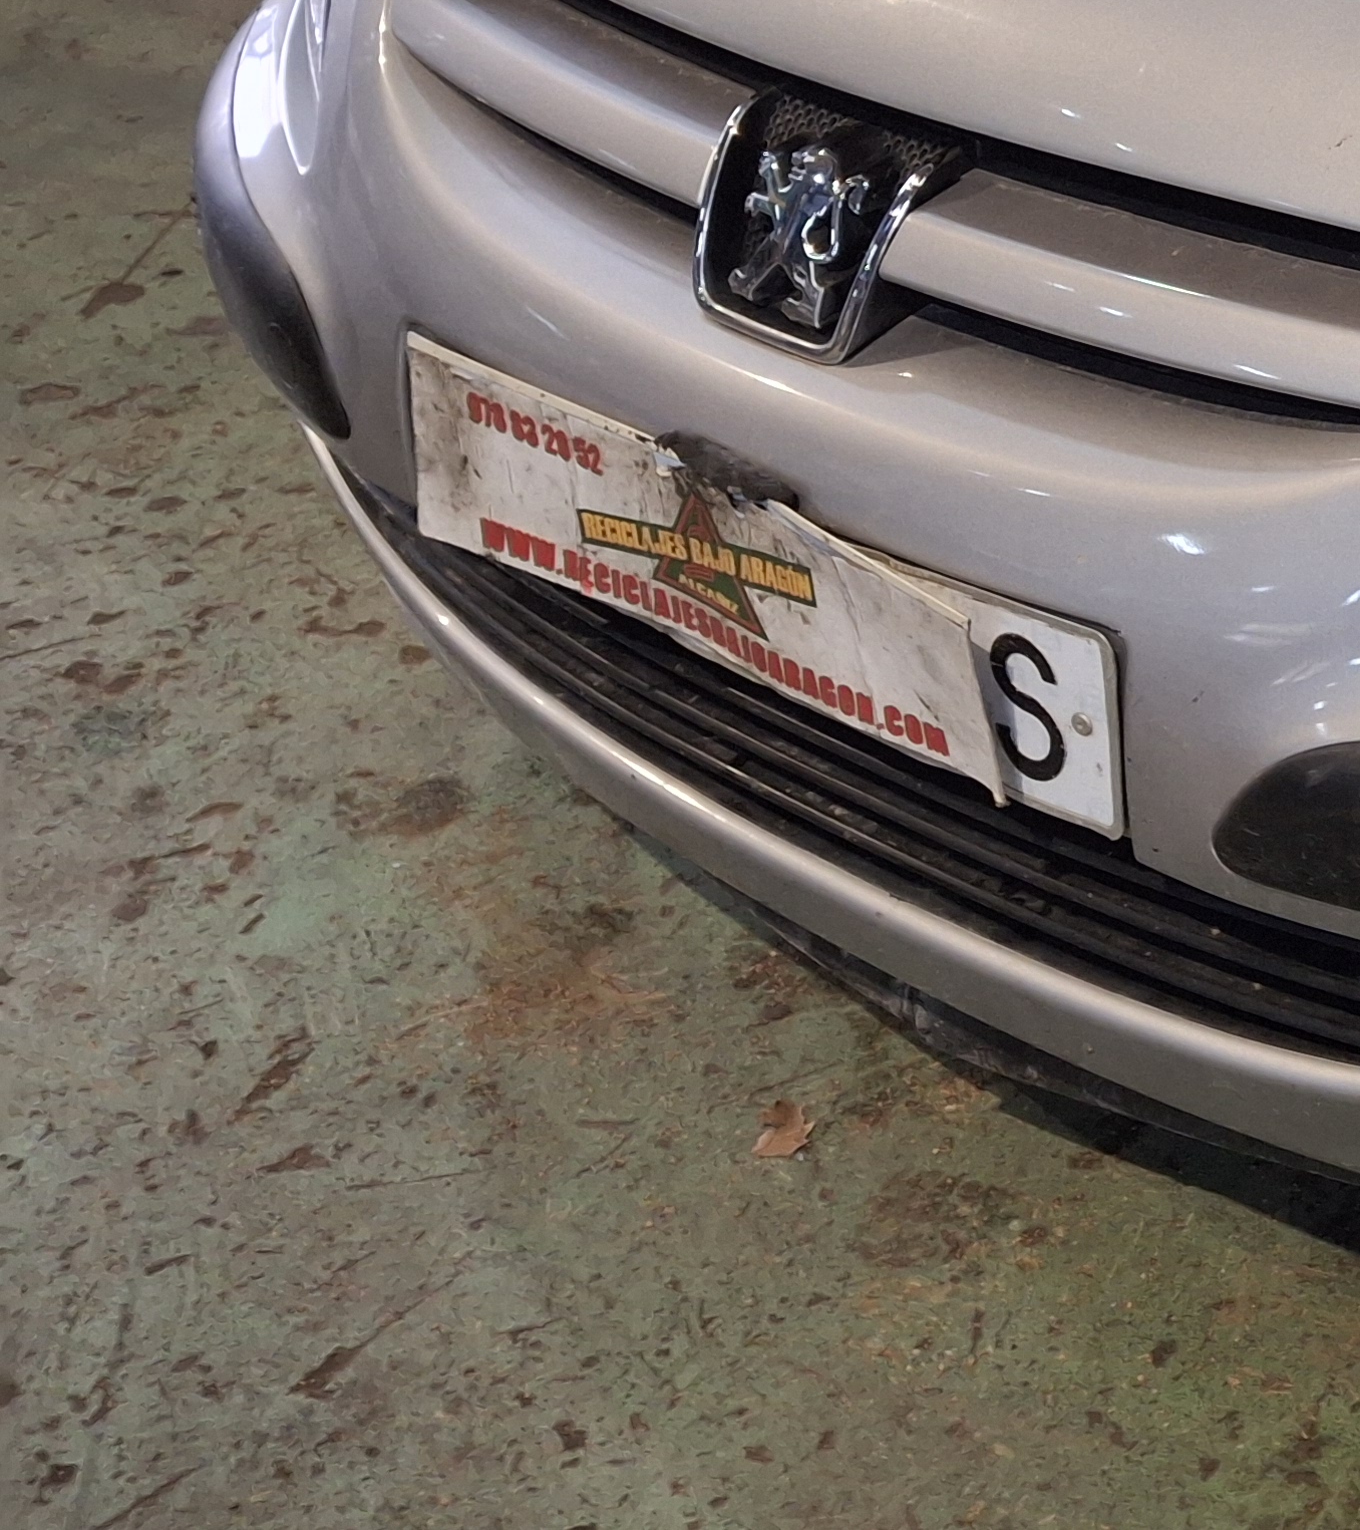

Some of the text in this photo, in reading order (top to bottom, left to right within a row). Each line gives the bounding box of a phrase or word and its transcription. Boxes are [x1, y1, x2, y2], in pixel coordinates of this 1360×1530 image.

[572, 436, 603, 476] 52
[581, 512, 688, 561] RECICLAJES
[689, 537, 736, 577] BAJO
[480, 517, 950, 757] WWW.RECICLAJESBAJOARAGON.COM
[989, 633, 1067, 782] S
